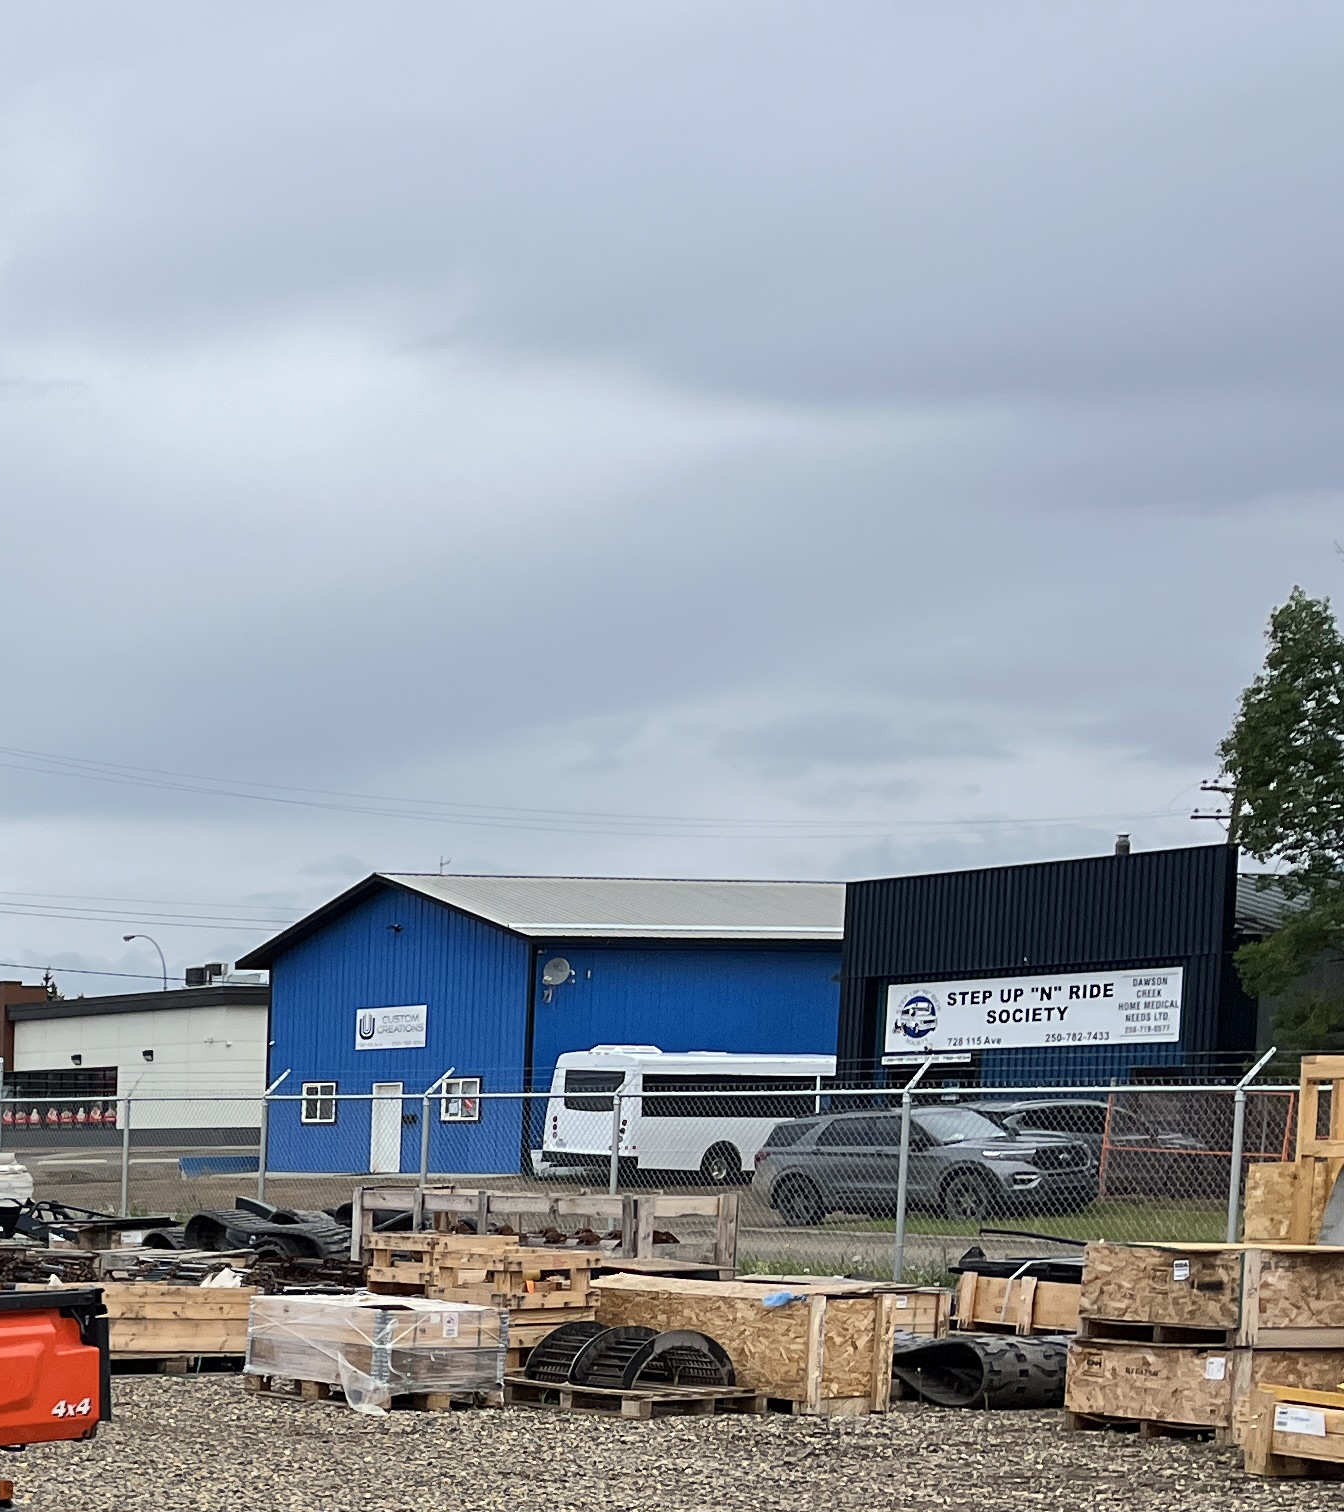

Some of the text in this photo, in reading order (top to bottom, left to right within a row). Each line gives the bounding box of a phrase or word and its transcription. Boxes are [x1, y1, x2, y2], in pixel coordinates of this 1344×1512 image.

[1133, 977, 1168, 987] DAWSON
[947, 983, 1114, 1006] STEP UP "N" RIDE
[1136, 989, 1163, 998] CREEK
[1118, 1000, 1179, 1011] HOME MEDICAL
[382, 1014, 420, 1024] CUSTOM
[986, 1006, 1069, 1024] SOCIETY
[1125, 1012, 1151, 1022] NEEDS
[377, 1023, 424, 1034] CREATIONS
[947, 1036, 1002, 1047] 728 115 Ave
[1045, 1031, 1110, 1043] 250-782-7433
[50, 1397, 91, 1417] 4x4
